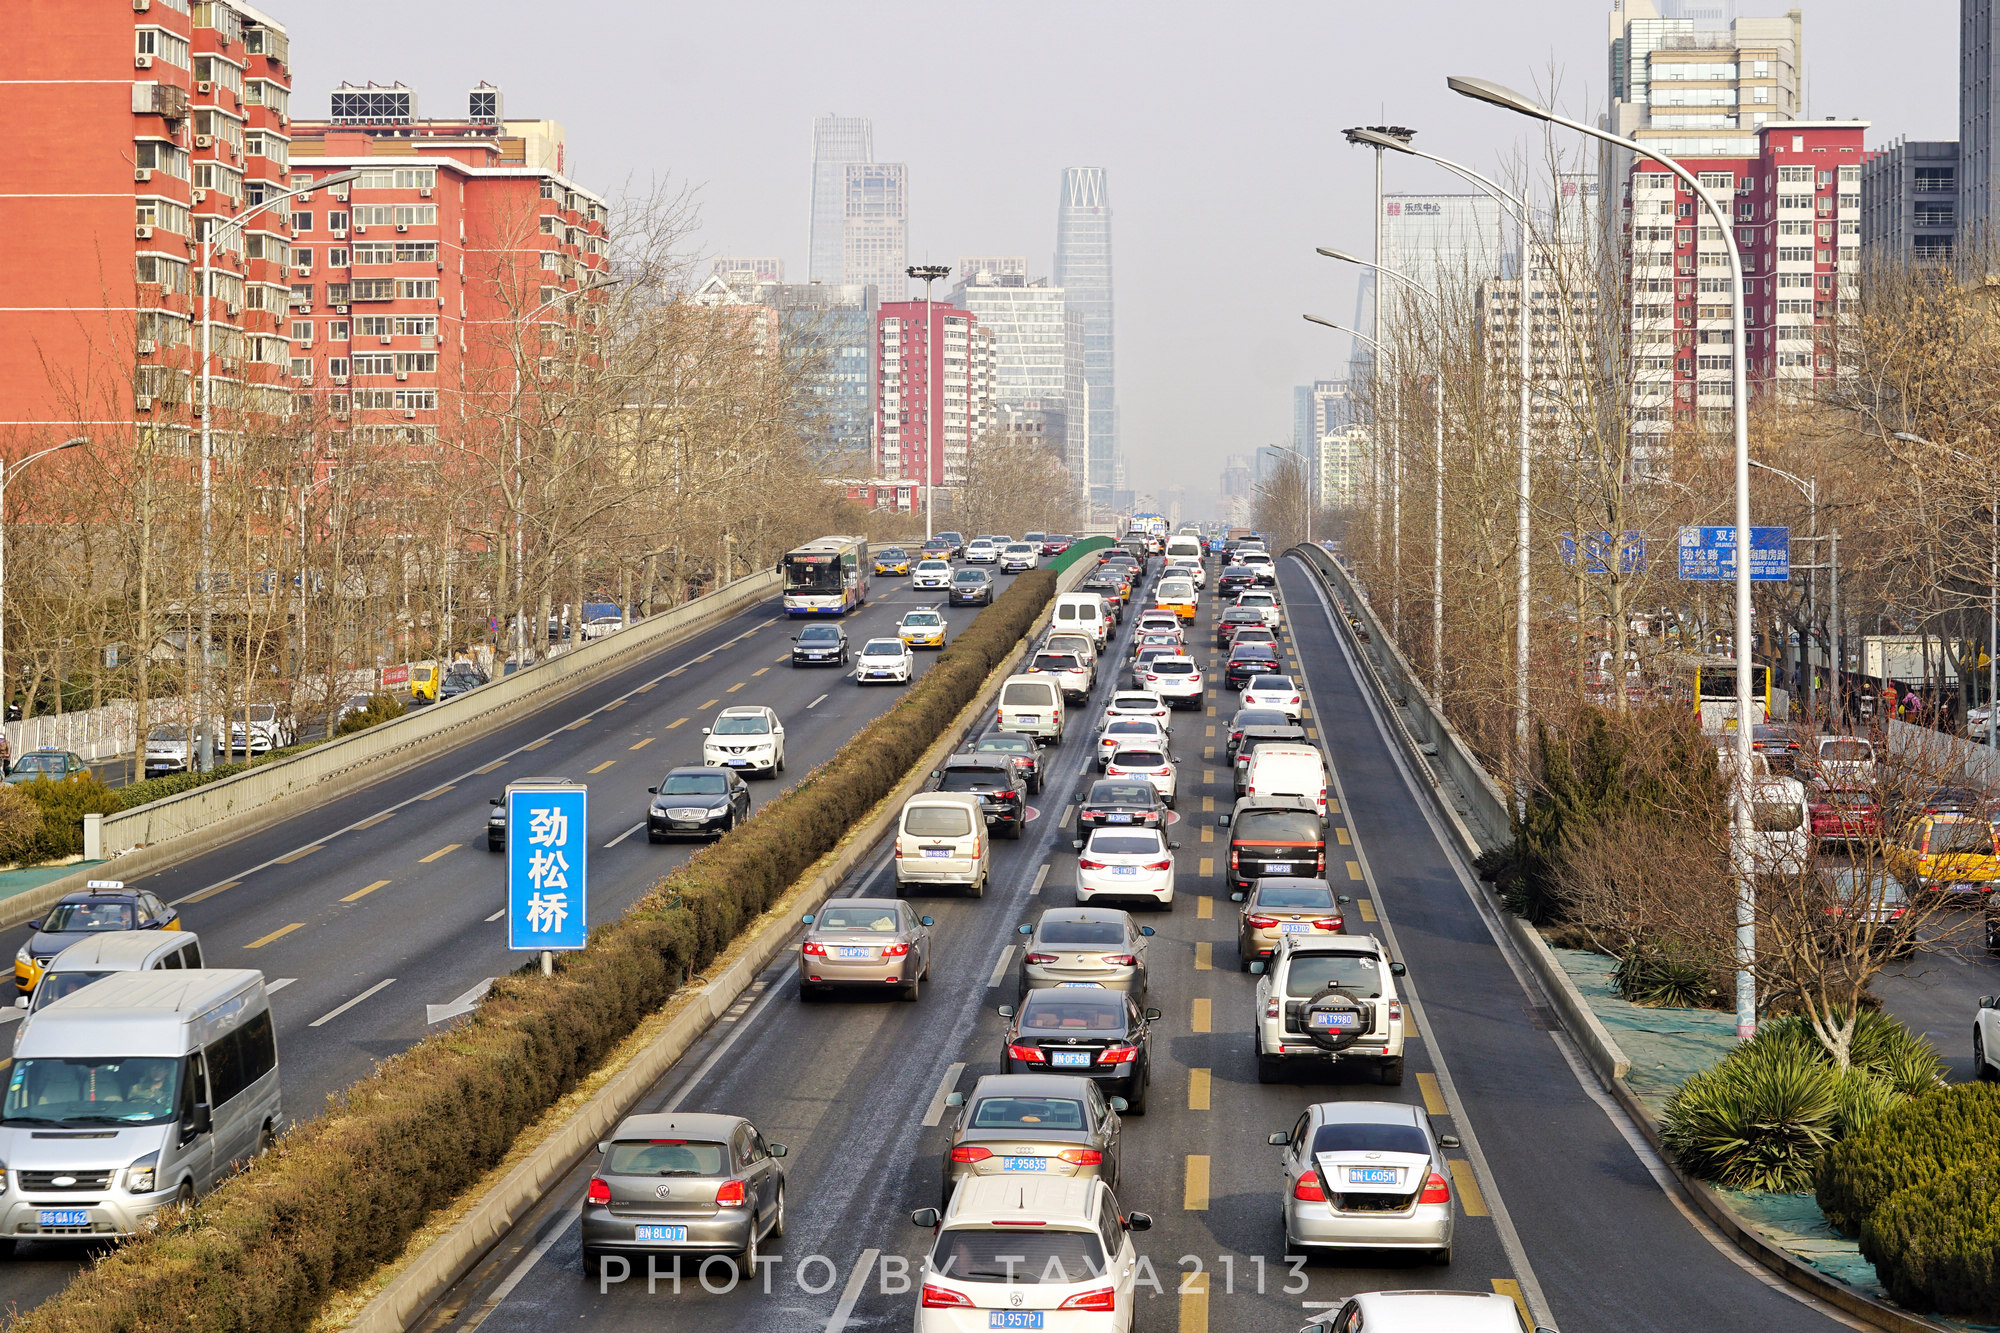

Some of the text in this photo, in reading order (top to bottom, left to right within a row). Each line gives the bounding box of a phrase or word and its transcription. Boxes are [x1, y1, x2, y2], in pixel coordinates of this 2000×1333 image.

[1405, 203, 1441, 211] 乐成中心
[526, 807, 570, 933] 劲松桥
